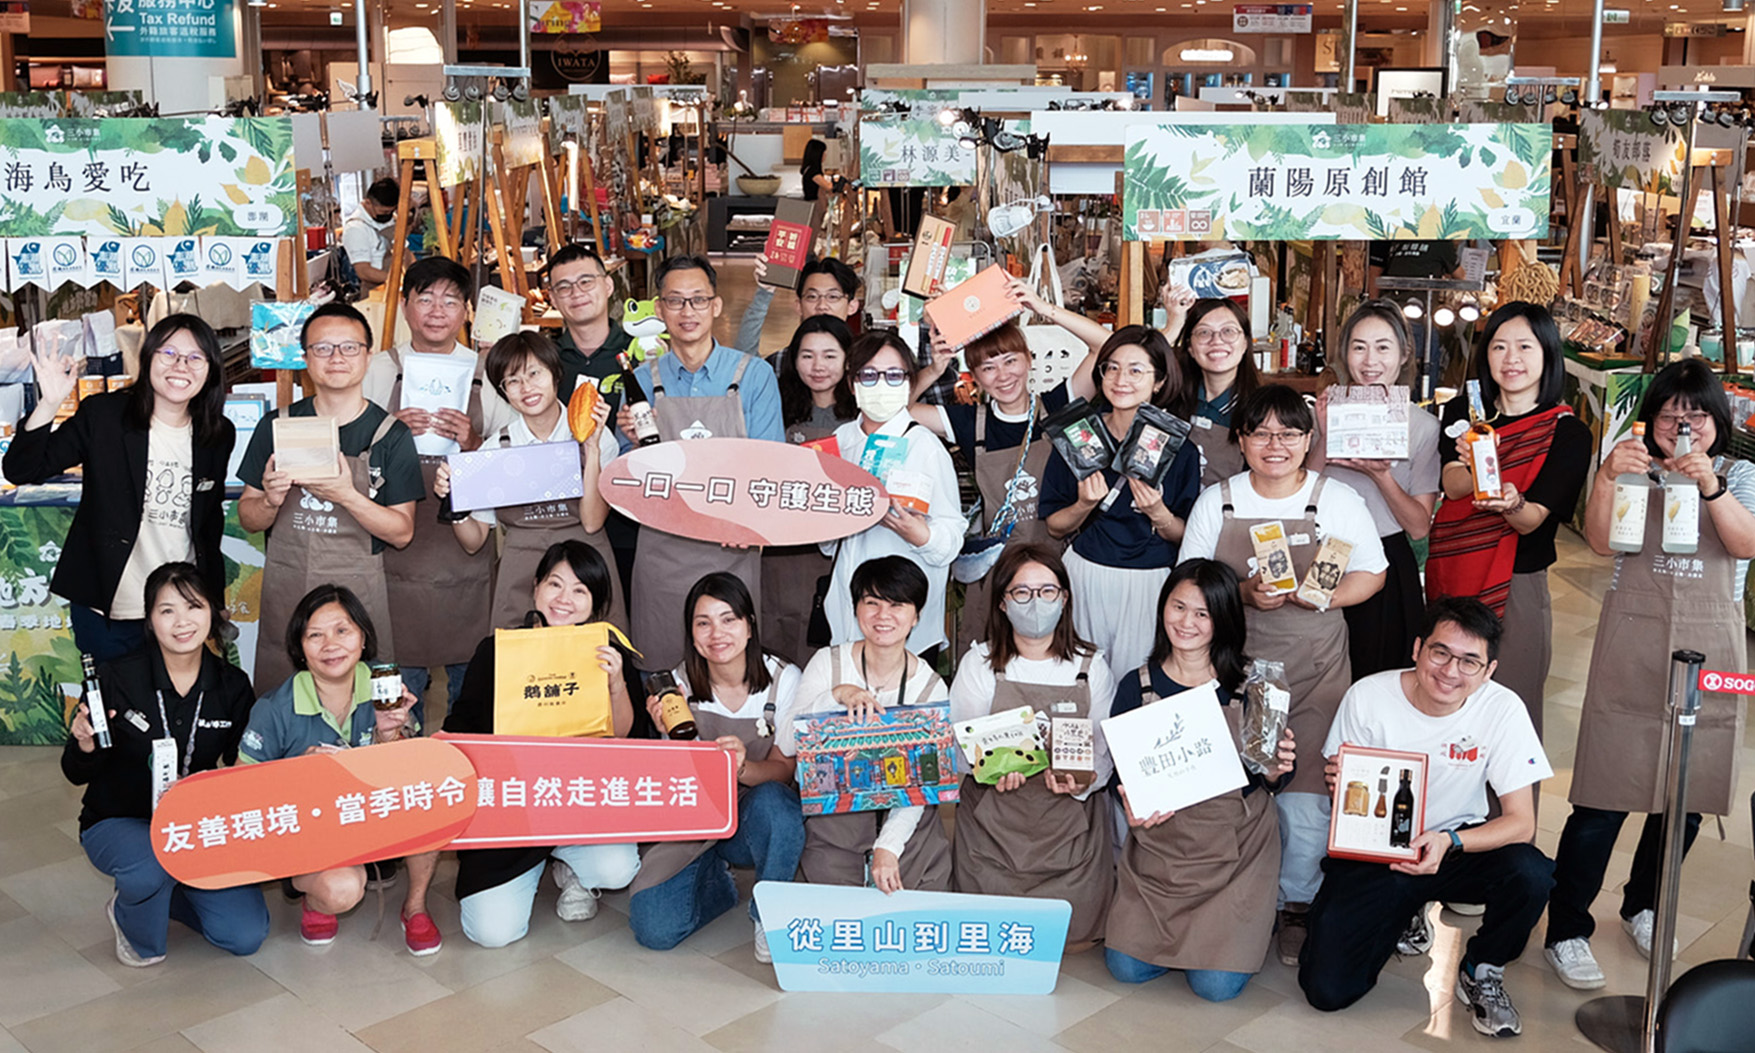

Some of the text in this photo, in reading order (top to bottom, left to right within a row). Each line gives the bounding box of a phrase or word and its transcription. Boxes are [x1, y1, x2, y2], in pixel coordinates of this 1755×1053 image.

[140, 13, 216, 26] Tax Refund
[557, 57, 596, 67] IWATA
[4, 161, 151, 194] 海鳥愛吃
[1248, 166, 1430, 199] 蘭陽原創館
[1501, 214, 1521, 225] 宜蘭
[611, 471, 876, 517] 一口一口 守護生態
[292, 512, 338, 528] 三小市集
[1653, 555, 1704, 572] 三小市集
[787, 918, 1035, 955] 從里山到里海
[817, 957, 909, 979] Satoyama
[927, 958, 1005, 977] Satoumi
